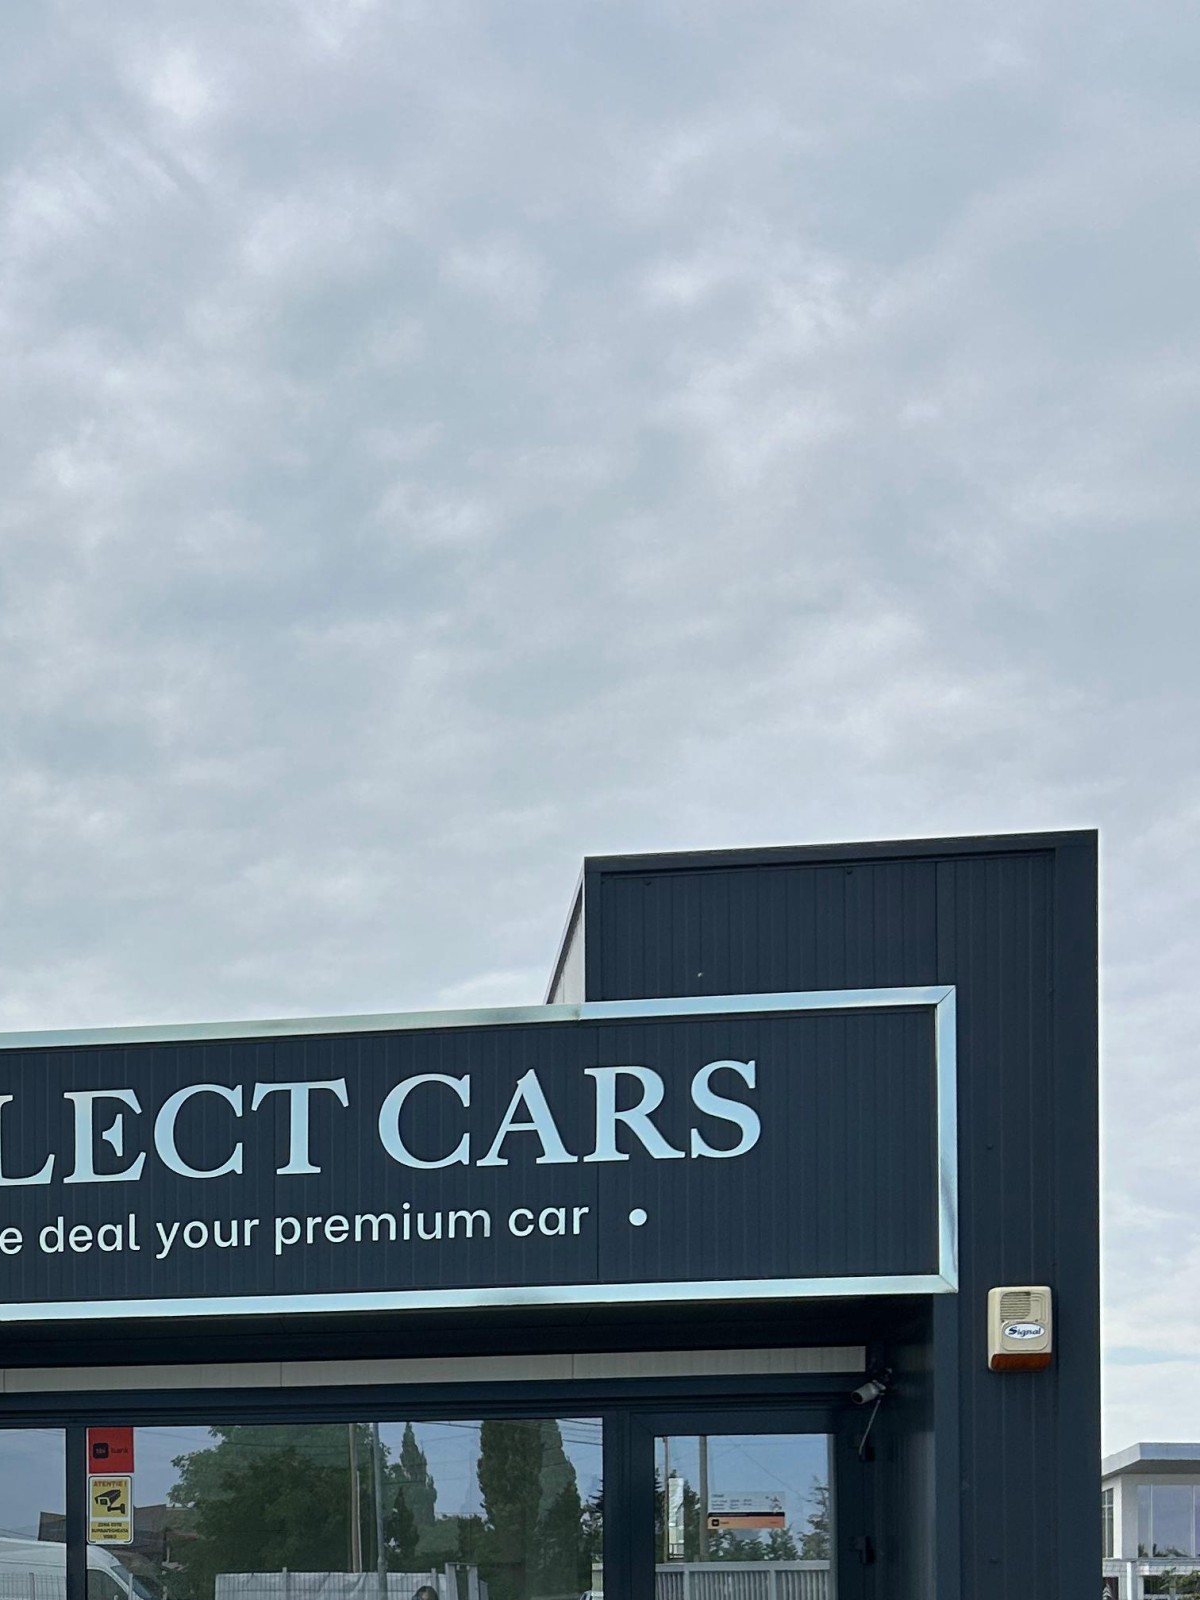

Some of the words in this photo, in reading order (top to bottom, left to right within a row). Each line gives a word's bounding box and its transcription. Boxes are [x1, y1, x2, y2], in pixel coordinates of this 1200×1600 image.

[378, 1060, 761, 1170] CARS
[39, 1213, 141, 1254] deal
[155, 1218, 260, 1260] your
[275, 1201, 491, 1256] premium
[508, 1206, 590, 1237] car
[1008, 1326, 1041, 1337] Signal
